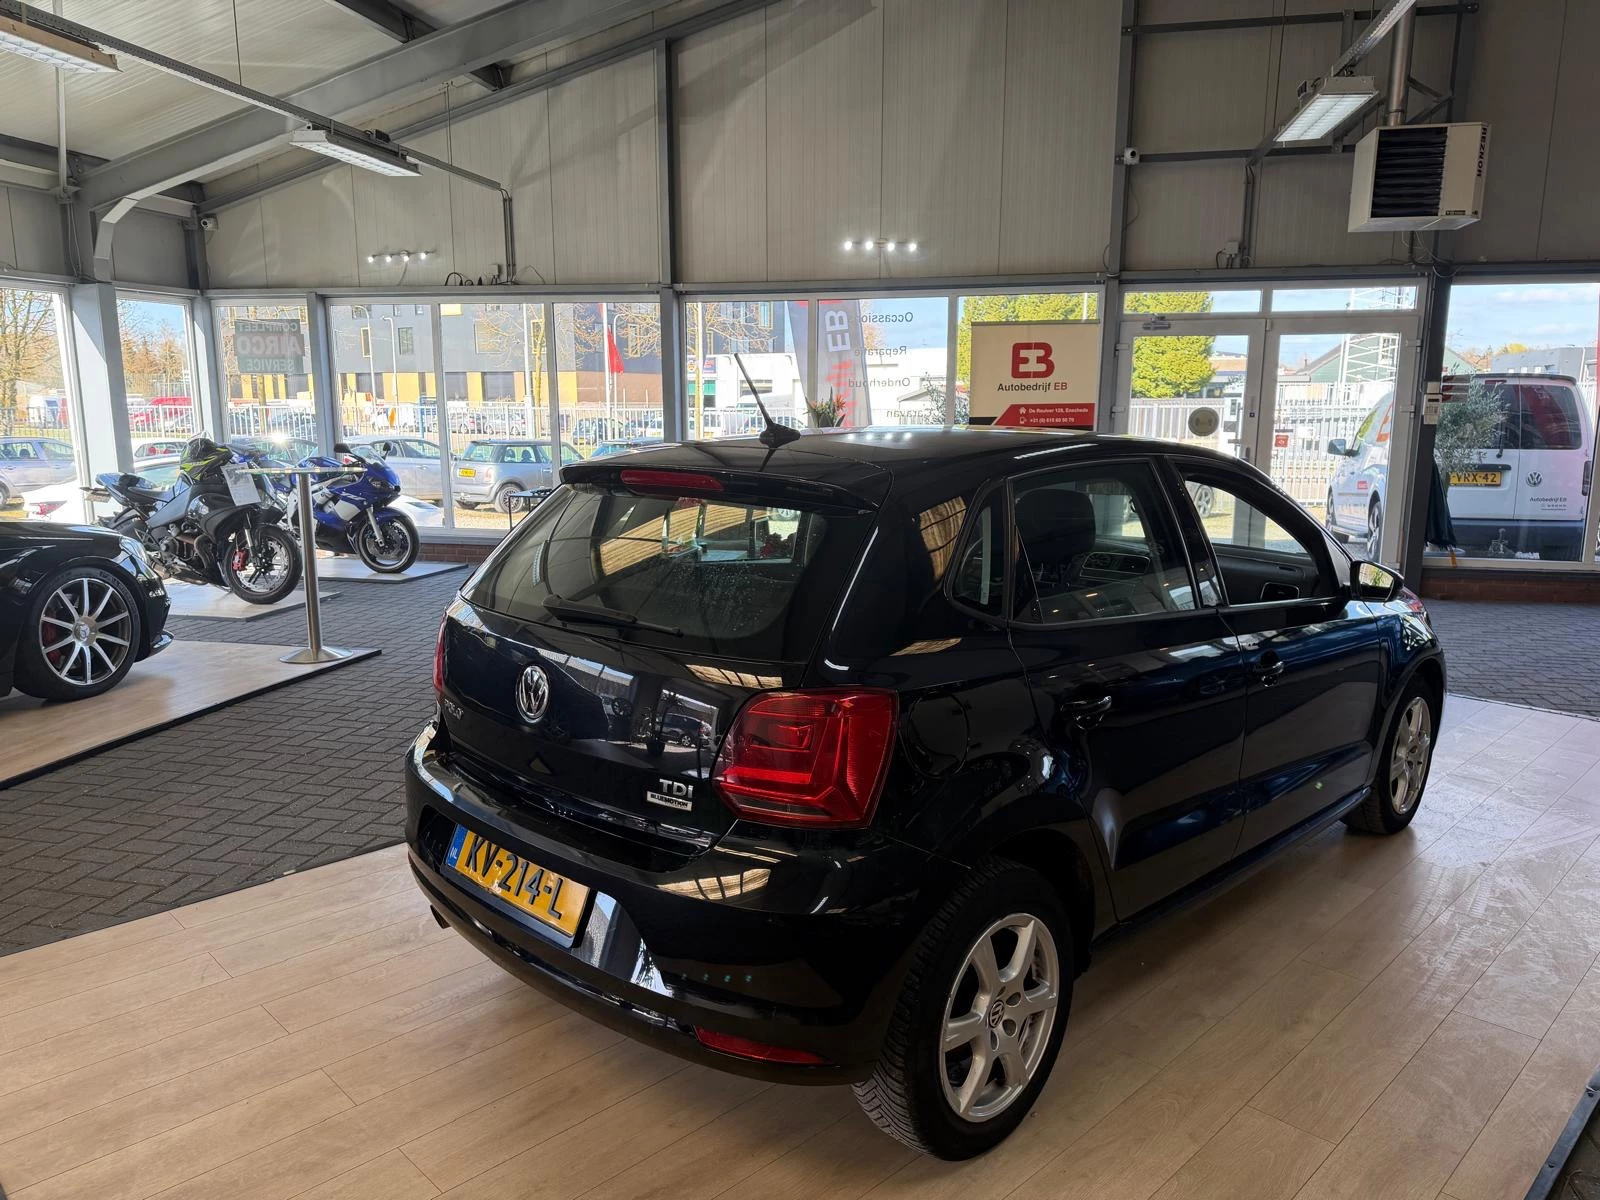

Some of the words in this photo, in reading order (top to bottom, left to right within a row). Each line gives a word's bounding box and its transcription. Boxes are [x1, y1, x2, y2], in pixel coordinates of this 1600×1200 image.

[1476, 127, 1488, 177] REZNOR
[825, 310, 851, 352] EB
[1011, 342, 1055, 379] EB
[997, 383, 1052, 392] Autobedrijf
[1053, 382, 1068, 391] EB
[1451, 473, 1497, 483] -VRX-42
[464, 833, 564, 921] KV-214-L
